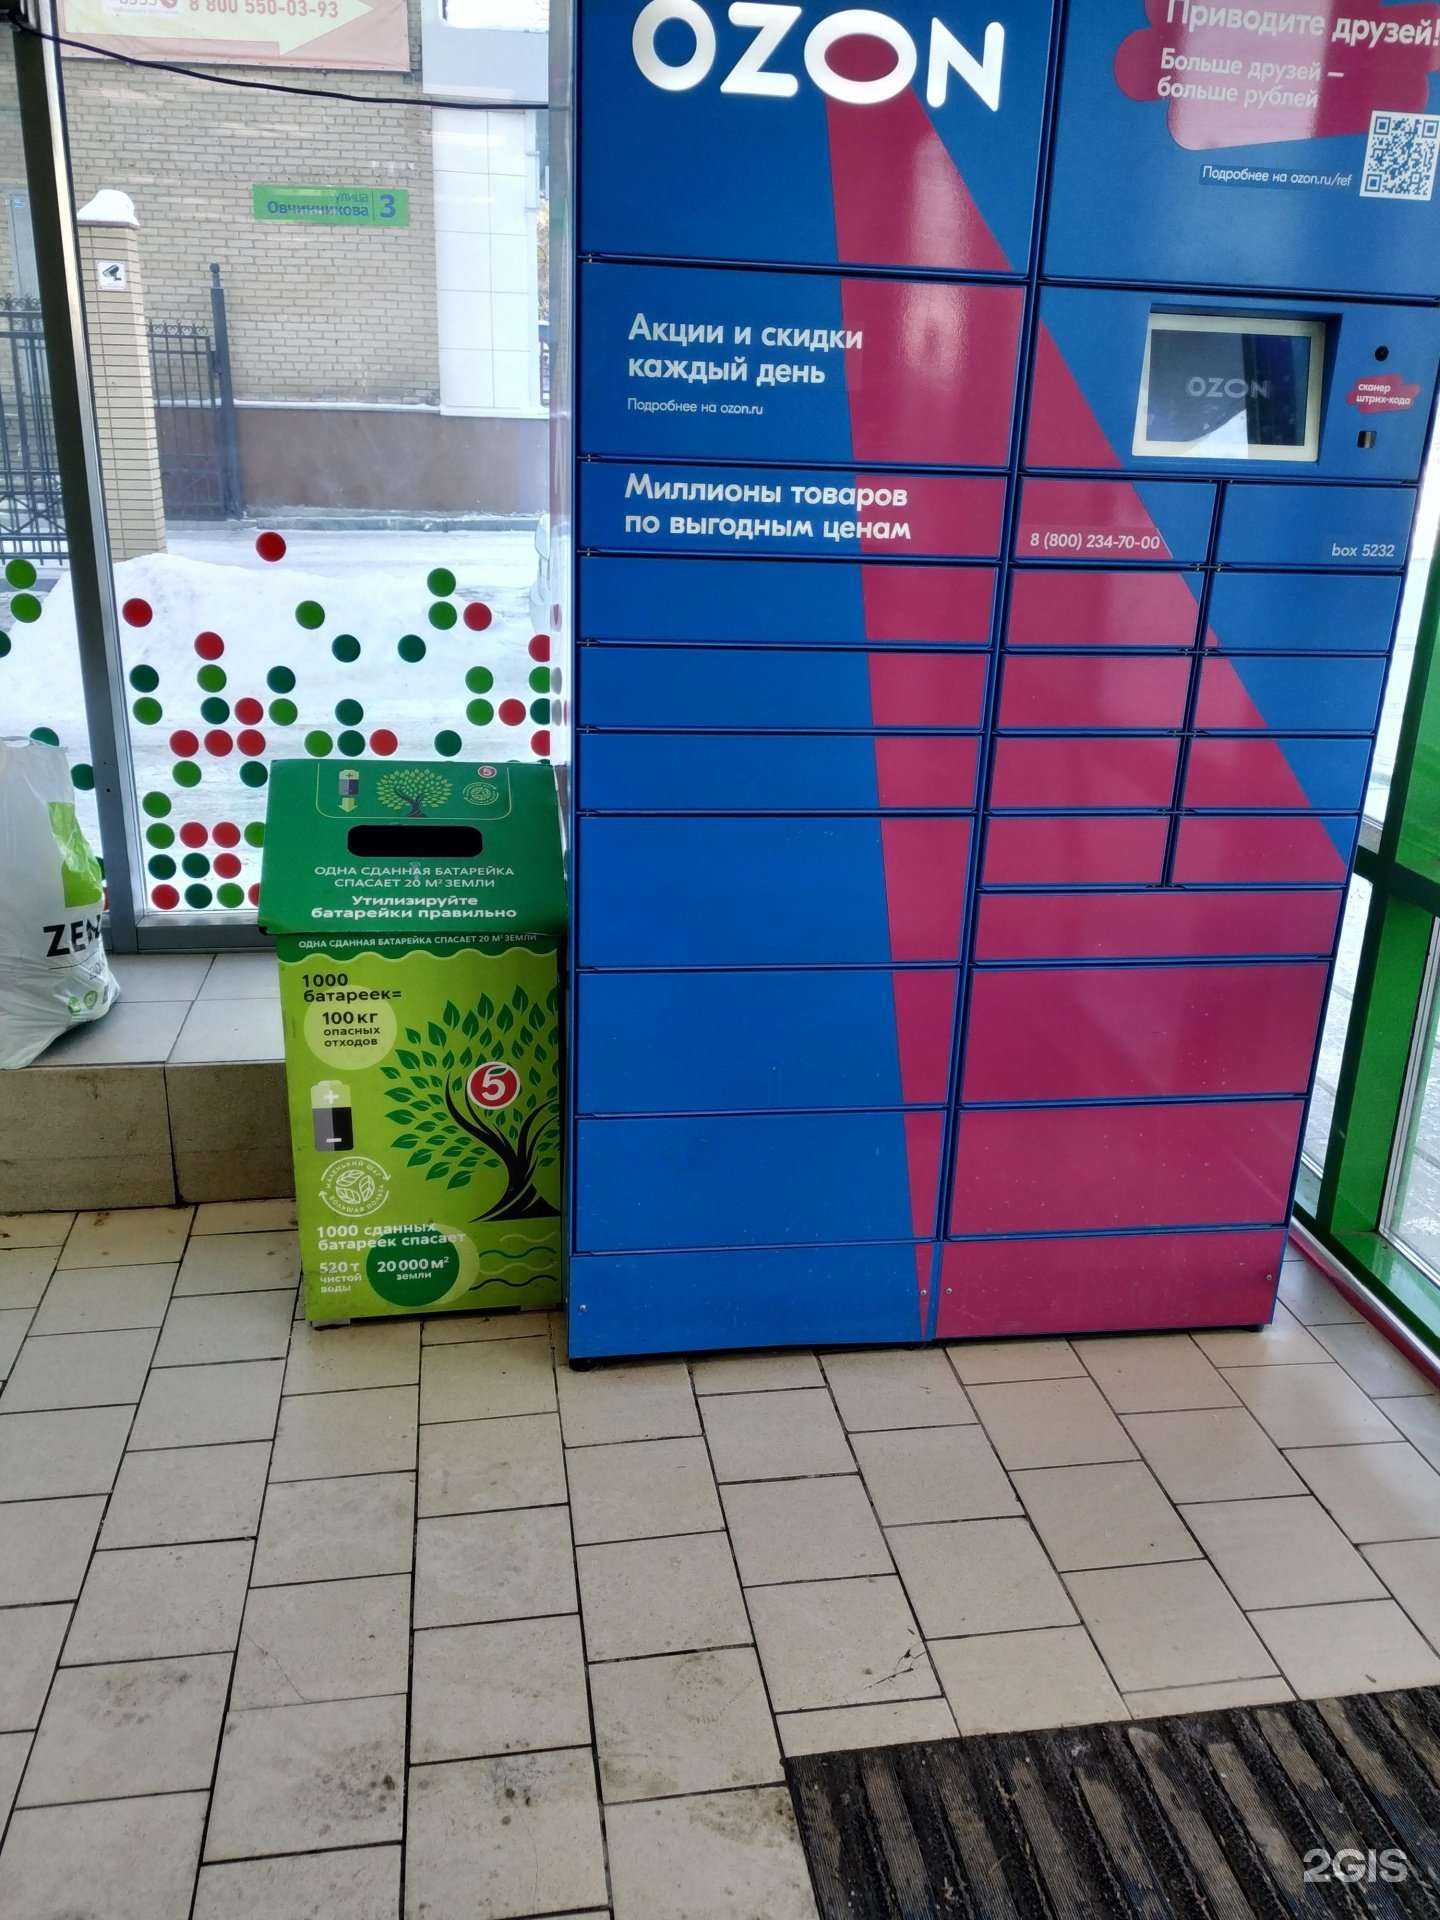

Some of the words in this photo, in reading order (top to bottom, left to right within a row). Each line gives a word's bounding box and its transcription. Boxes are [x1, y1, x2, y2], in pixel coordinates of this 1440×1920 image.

[207, 0, 238, 13] 800
[245, 0, 338, 18] 550-03-93
[1167, 0, 1325, 35] Приводите
[1331, 17, 1440, 47] друзей!
[632, 0, 1004, 112] OZON
[1160, 48, 1242, 76] Больше
[1247, 60, 1322, 82] друзей
[1157, 76, 1238, 102] больше
[1244, 85, 1320, 108] рублей
[1202, 165, 1269, 183] Подробнее
[1272, 173, 1287, 183] на
[1290, 172, 1353, 186] ozon.ru/ref
[380, 194, 396, 218] 3
[628, 312, 724, 347] Акции
[734, 325, 752, 346] и
[761, 326, 863, 352] скидки
[628, 356, 748, 384] каждый
[756, 361, 826, 387] день
[1187, 376, 1271, 399] OZON
[1358, 383, 1392, 394] сканер
[627, 397, 698, 414] Подробнее
[701, 402, 717, 413] на
[720, 403, 764, 415] ozon.ru
[624, 472, 782, 503] Миллионы
[790, 485, 909, 512] товаров
[624, 515, 660, 534] по
[669, 515, 813, 540] выгодным
[823, 519, 912, 543] ценам
[1030, 532, 1040, 547] 8
[1044, 531, 1083, 551] (800)
[1086, 534, 1160, 549] 234-70-00
[1331, 543, 1358, 557] box
[1361, 543, 1396, 557] 5232
[314, 866, 357, 876] ОДНА
[360, 866, 431, 876] СДАННАЯ
[435, 865, 515, 876] БАТАРЕЙКА
[334, 878, 400, 888] СПАСАЕТ
[404, 879, 421, 888] 20
[444, 879, 496, 888] ЗЕМЛИ
[352, 895, 479, 908] Утилизируйте
[311, 907, 413, 920] батарейки
[418, 908, 518, 919] правильно
[298, 940, 327, 949] ОДНА
[329, 938, 376, 948] СДАННАЯ
[378, 935, 432, 946] БАТАРЕЙКА
[434, 935, 477, 944] СПАСАЕТ
[479, 935, 489, 943] 20
[302, 973, 348, 988] 1000
[304, 988, 402, 1004] батареек=
[322, 1011, 354, 1025] 100
[357, 1012, 378, 1024] кг
[323, 1026, 380, 1036] опасных
[324, 1037, 378, 1047] отходов
[317, 1225, 358, 1238] 1000
[364, 1223, 437, 1237] сданных
[318, 1237, 397, 1251] батареек
[401, 1233, 466, 1245] спасает
[319, 1262, 348, 1274] 520
[320, 1273, 361, 1283] чистой
[396, 1272, 432, 1281] земли
[320, 1285, 351, 1294] воды
